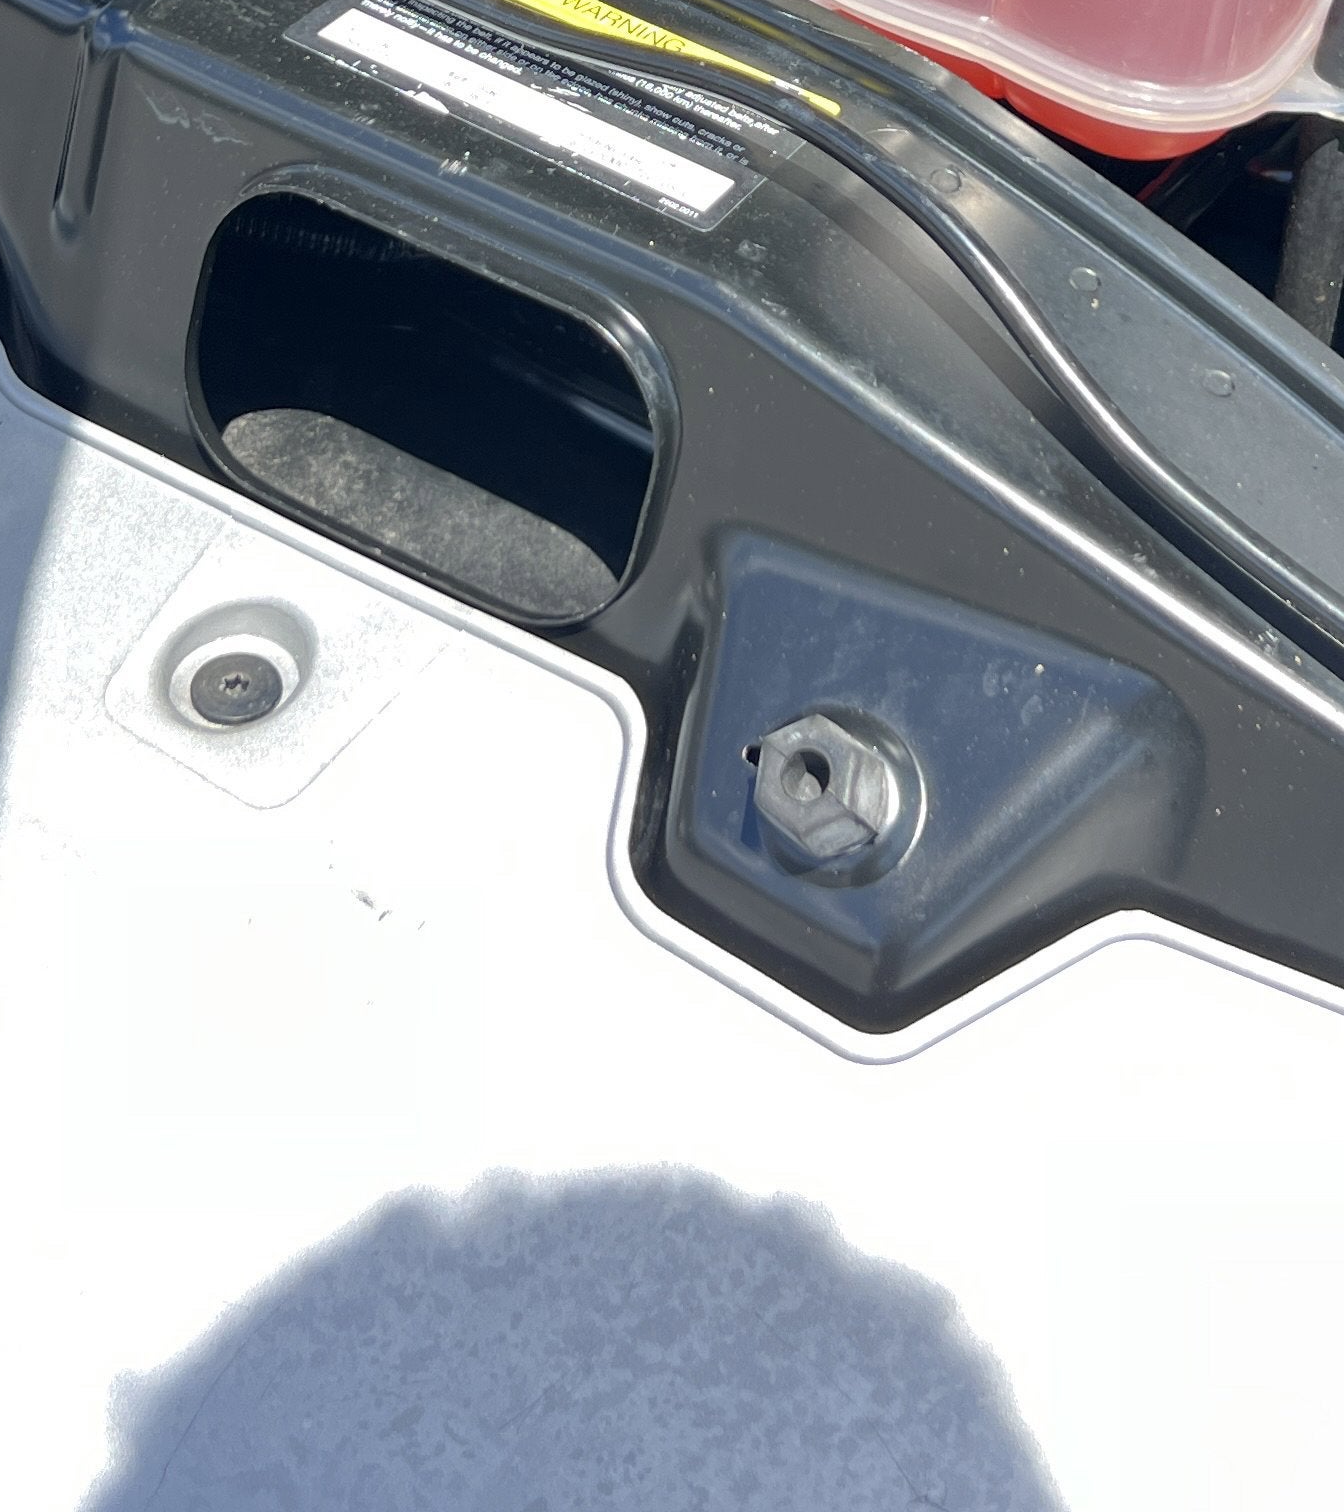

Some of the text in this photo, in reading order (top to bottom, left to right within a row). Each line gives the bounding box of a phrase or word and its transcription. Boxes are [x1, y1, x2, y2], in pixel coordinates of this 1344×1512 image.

[432, 31, 456, 43] has
[451, 39, 467, 48] to
[462, 44, 482, 55] be
[493, 48, 520, 61] side
[453, 20, 474, 31] the
[507, 45, 551, 66] appears
[547, 61, 563, 70] to
[559, 66, 578, 76] be
[571, 73, 611, 93] glazed
[641, 104, 674, 120] show
[695, 127, 734, 147] cracks
[730, 143, 747, 152] or
[681, 89, 731, 113] adjusted
